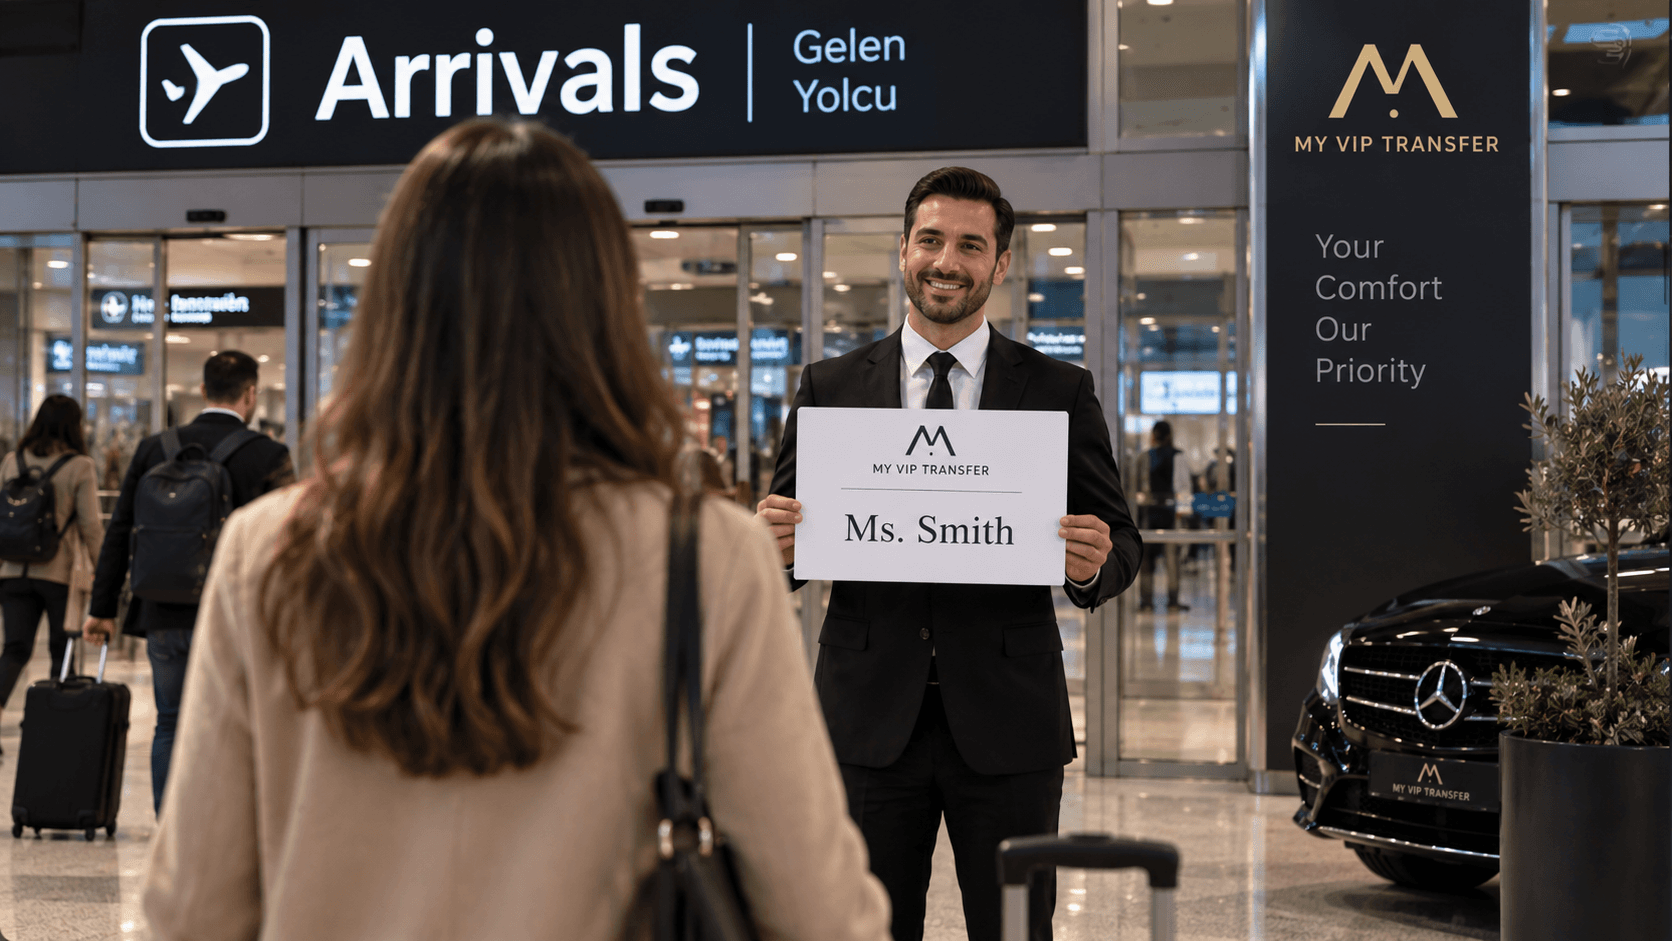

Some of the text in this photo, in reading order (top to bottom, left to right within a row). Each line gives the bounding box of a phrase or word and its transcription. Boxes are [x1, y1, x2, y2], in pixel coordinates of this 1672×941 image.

[793, 27, 906, 65] Gelen
[314, 27, 700, 121] Arrivals
[792, 76, 897, 113] Yolcu
[1295, 135, 1499, 153] MY VIP TRANSFER
[1315, 233, 1385, 259] Your
[1315, 273, 1443, 301] Comfort
[1315, 316, 1372, 342] Our
[1316, 357, 1427, 390] Priority
[872, 463, 990, 476] MY VIP TRANSFER
[844, 513, 1015, 546] Ms. Smith
[1392, 783, 1470, 801] MY VIP TRANSFER
